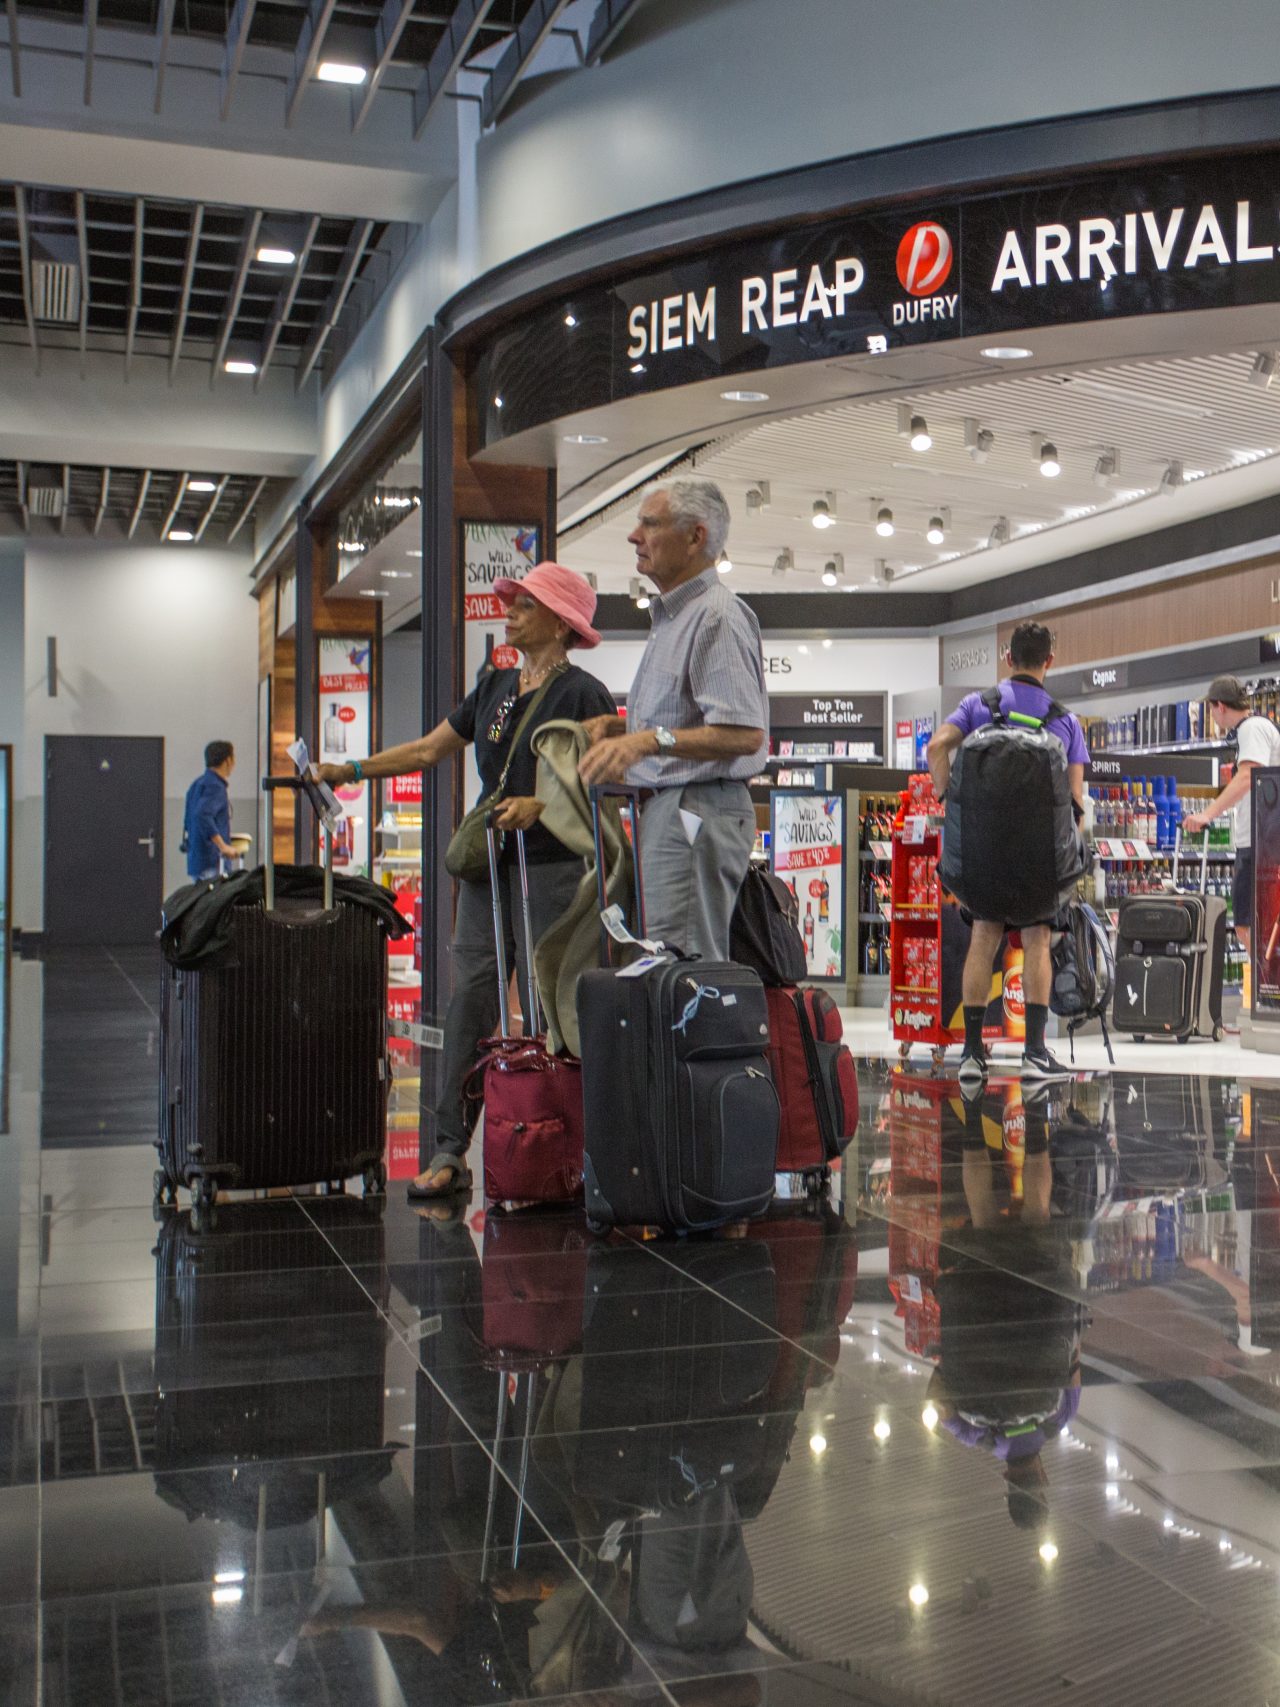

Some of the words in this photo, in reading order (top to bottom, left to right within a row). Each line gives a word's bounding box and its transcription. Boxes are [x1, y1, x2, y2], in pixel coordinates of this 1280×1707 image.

[627, 287, 718, 360] SIEM
[740, 257, 865, 334] REAP
[892, 294, 959, 326] DUFRY
[488, 551, 513, 563] WILD
[1092, 668, 1117, 686] Cognac
[812, 699, 832, 712] Top
[835, 699, 853, 711] Ten
[803, 712, 828, 724] Best
[830, 712, 863, 724] Seller
[1091, 760, 1121, 774] SPIRITS
[784, 821, 833, 844] SAVINGS
[787, 851, 807, 869] SAVE
